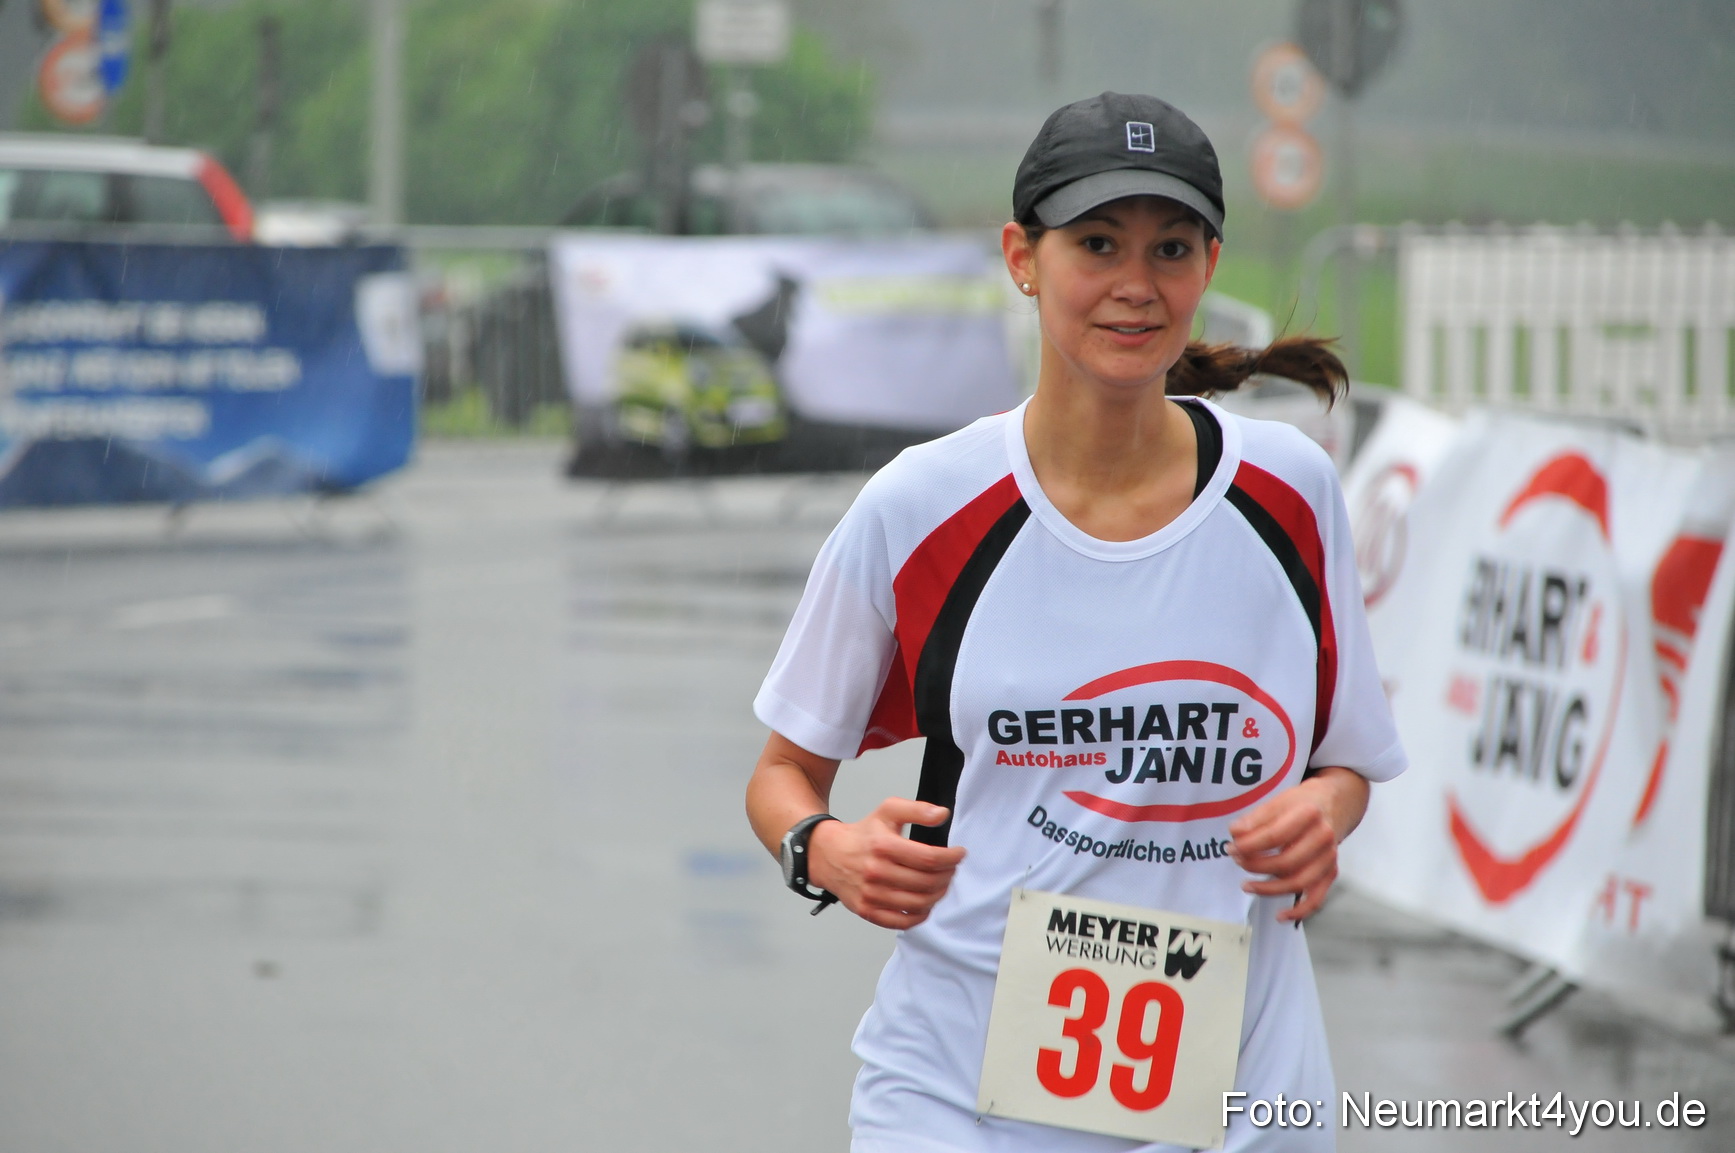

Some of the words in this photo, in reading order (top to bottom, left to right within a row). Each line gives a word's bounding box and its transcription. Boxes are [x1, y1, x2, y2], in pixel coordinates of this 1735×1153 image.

[988, 703, 1239, 745] GERHART
[1242, 717, 1260, 739] &
[995, 750, 1107, 768] Autohaus
[1105, 746, 1263, 785] JÄNIG
[1047, 907, 1160, 948] MEYER
[1046, 935, 1157, 970] WERBUNG
[1036, 967, 1185, 1112] 39
